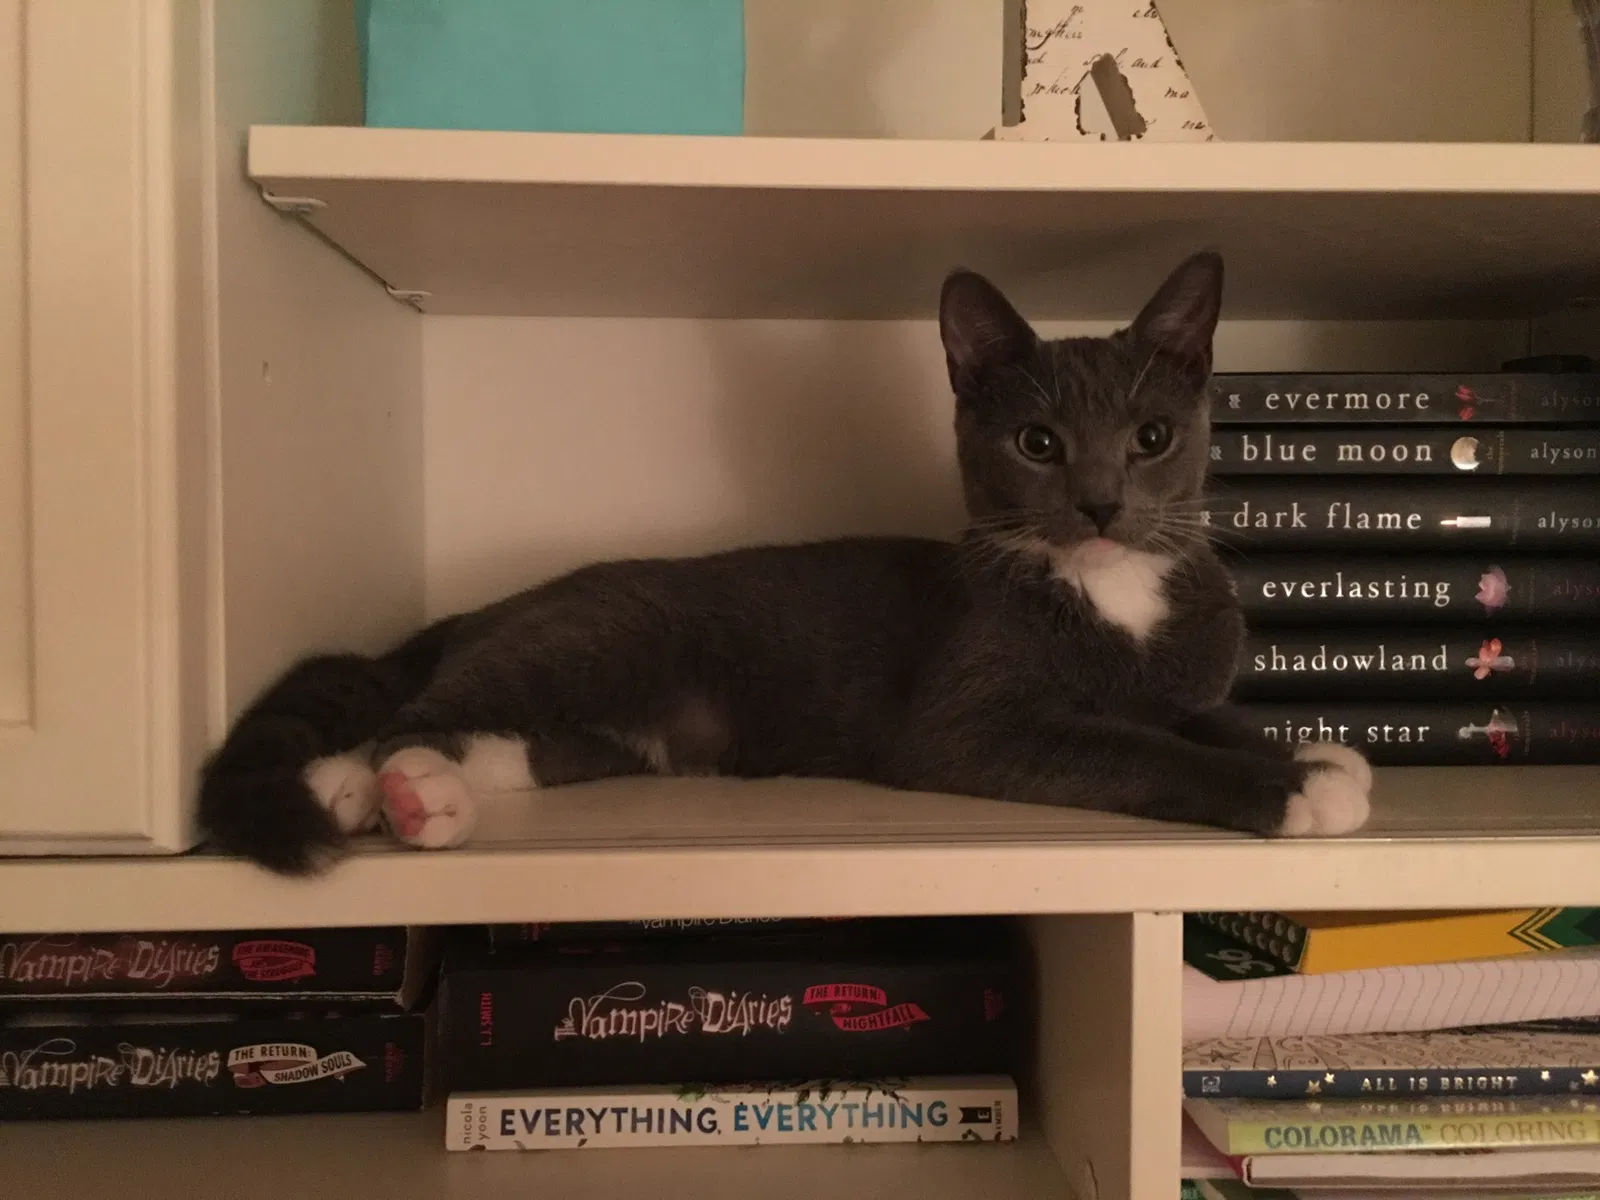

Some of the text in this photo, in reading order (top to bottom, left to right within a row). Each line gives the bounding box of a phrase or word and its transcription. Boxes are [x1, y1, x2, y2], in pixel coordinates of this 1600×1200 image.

[1265, 391, 1430, 410] evermore
[1242, 435, 1433, 462] blue moon
[1530, 442, 1597, 465] alyson
[1233, 502, 1422, 529] dark flame
[1262, 572, 1452, 607] everlasting
[1254, 645, 1449, 671] shadowland
[1263, 716, 1431, 744] night star
[810, 986, 828, 999] THE
[843, 1003, 915, 1029] NIGHTFALL
[234, 1044, 312, 1061] THE RETURN:
[274, 1053, 352, 1083] SHADOW SOULS
[1360, 1075, 1519, 1092] ALL IS BRIGHT
[460, 1103, 473, 1144] nicola
[478, 1106, 491, 1141] yoon
[499, 1101, 949, 1137] EVERYTHING, EVERYTHING
[1439, 1119, 1586, 1143] COLORING
